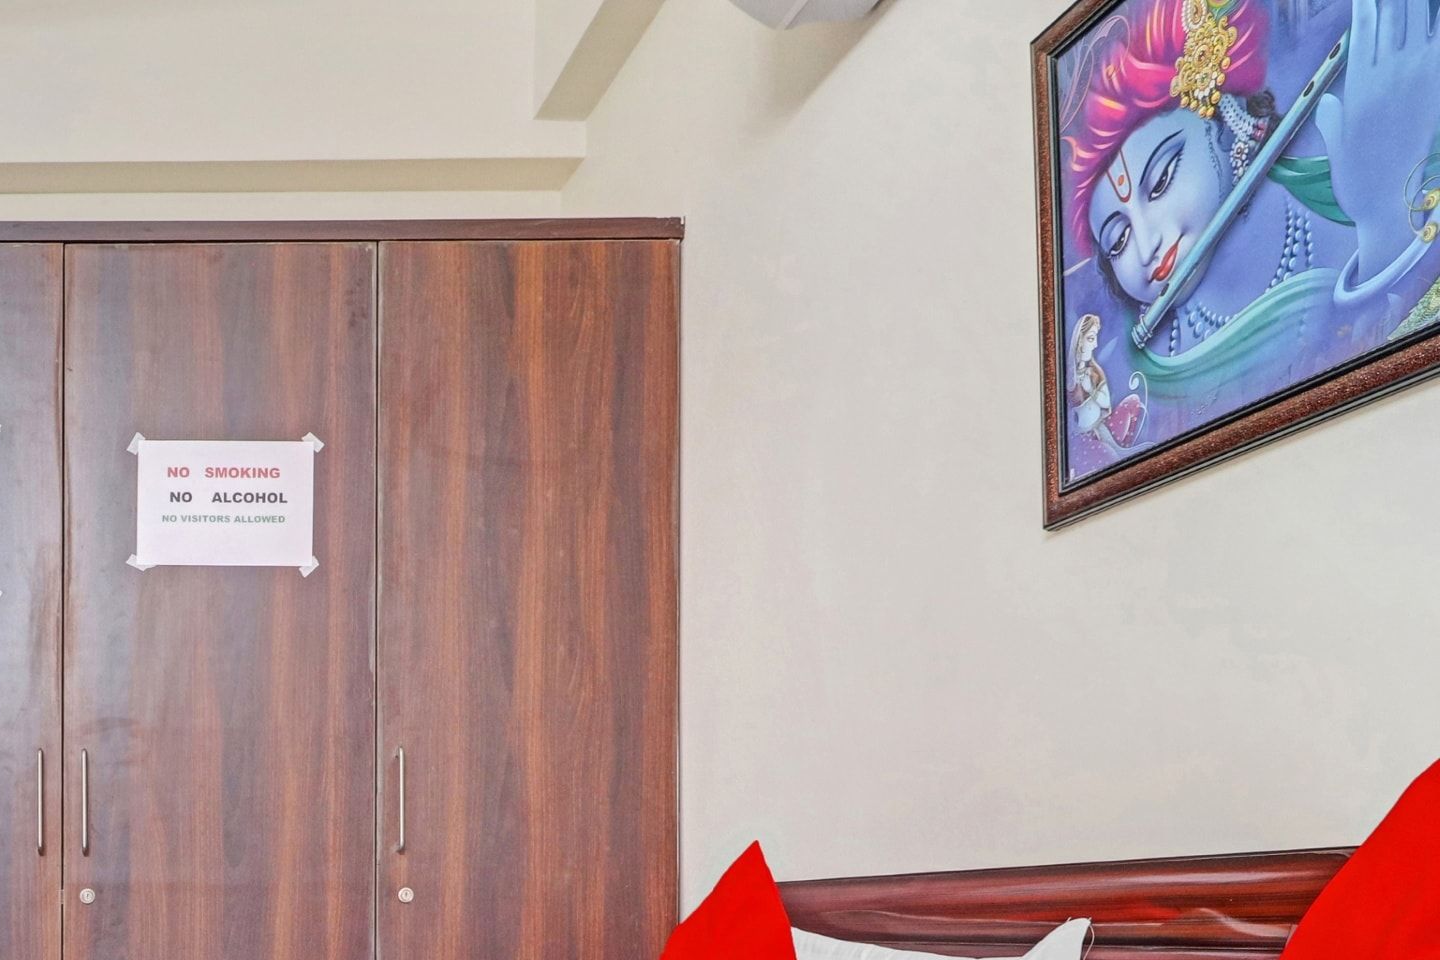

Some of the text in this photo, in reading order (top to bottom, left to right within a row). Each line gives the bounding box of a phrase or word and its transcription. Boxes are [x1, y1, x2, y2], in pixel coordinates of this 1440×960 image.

[167, 467, 281, 479] NO SMOKING
[169, 492, 288, 504] NO ALCOHOL
[162, 515, 286, 524] NO VISITORS ALLOWED
